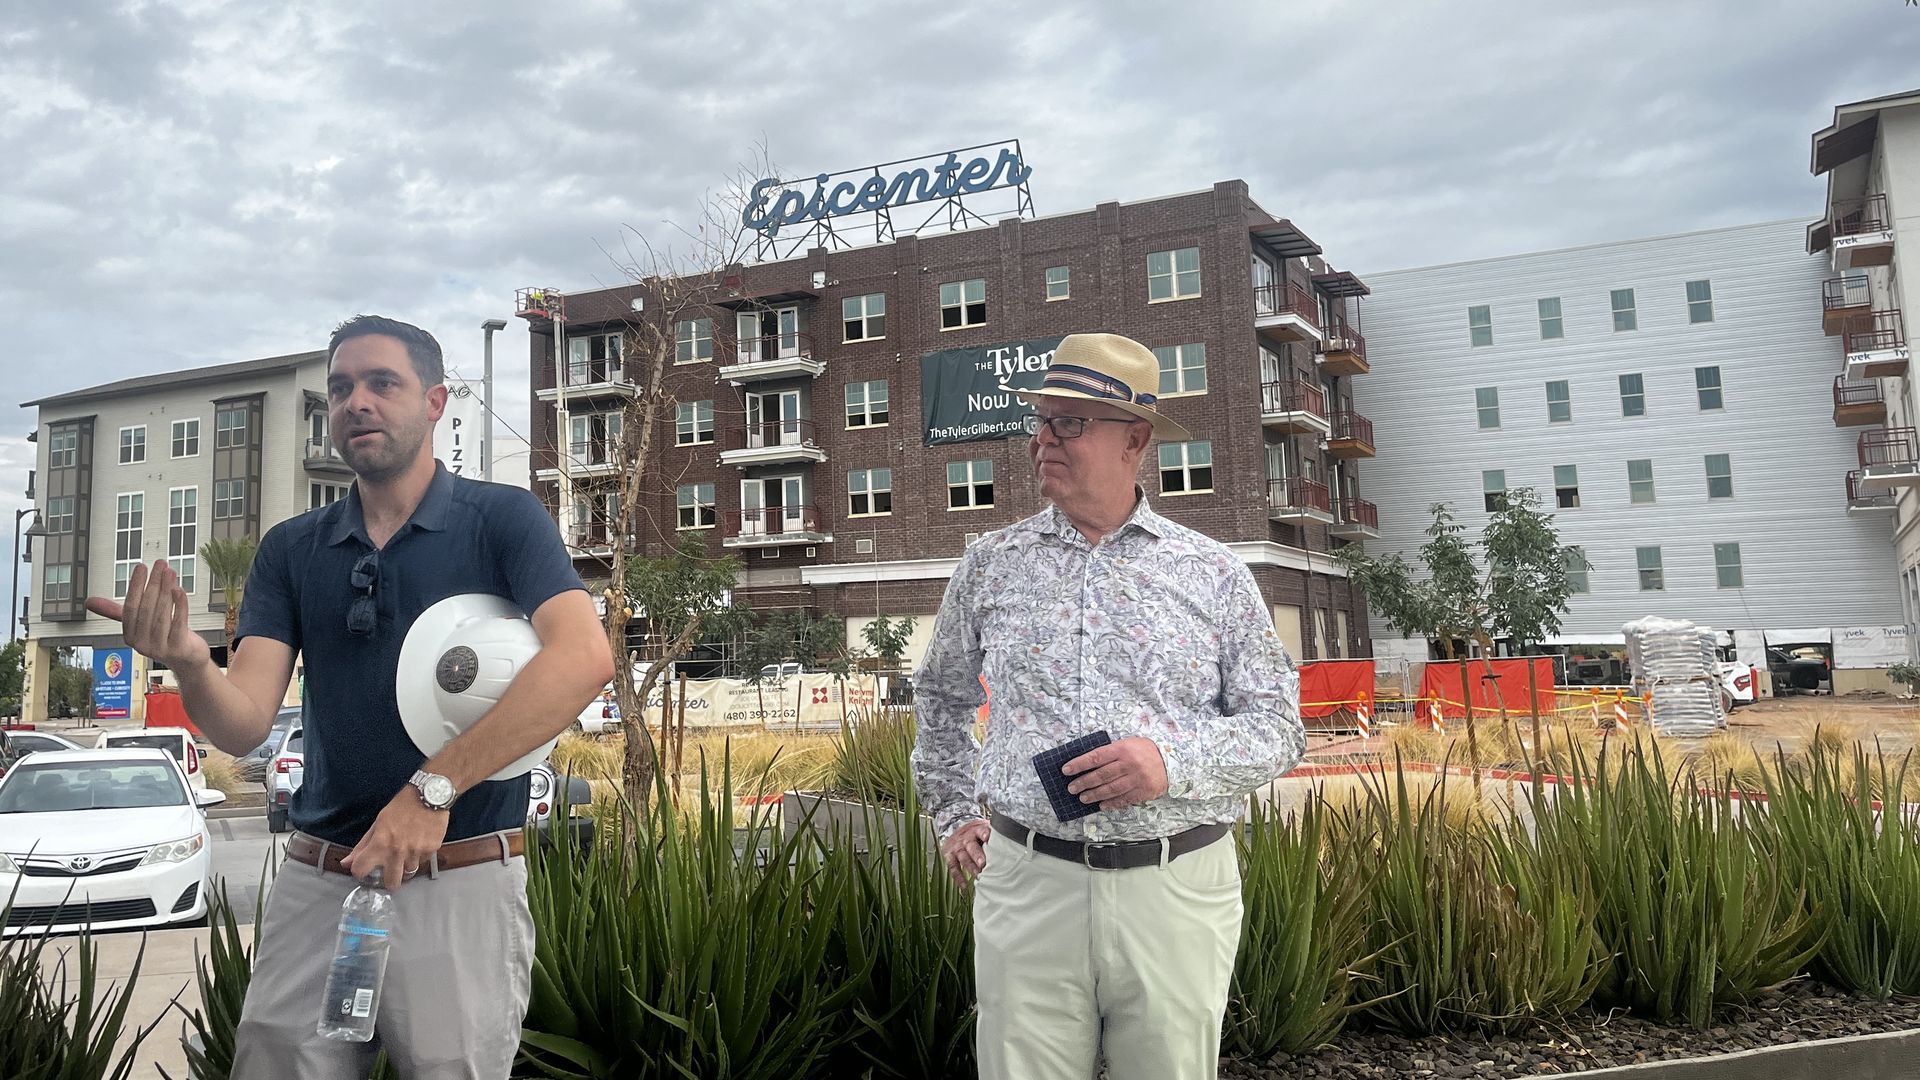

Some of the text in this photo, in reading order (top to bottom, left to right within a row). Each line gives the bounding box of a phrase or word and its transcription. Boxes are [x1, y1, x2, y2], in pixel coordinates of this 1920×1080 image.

[742, 148, 1032, 237] Epicenter
[975, 345, 1057, 385] THE Tyler
[968, 392, 1010, 413] Now
[728, 687, 763, 696] RESTAURAT
[723, 709, 796, 722] (480) 390-2262
